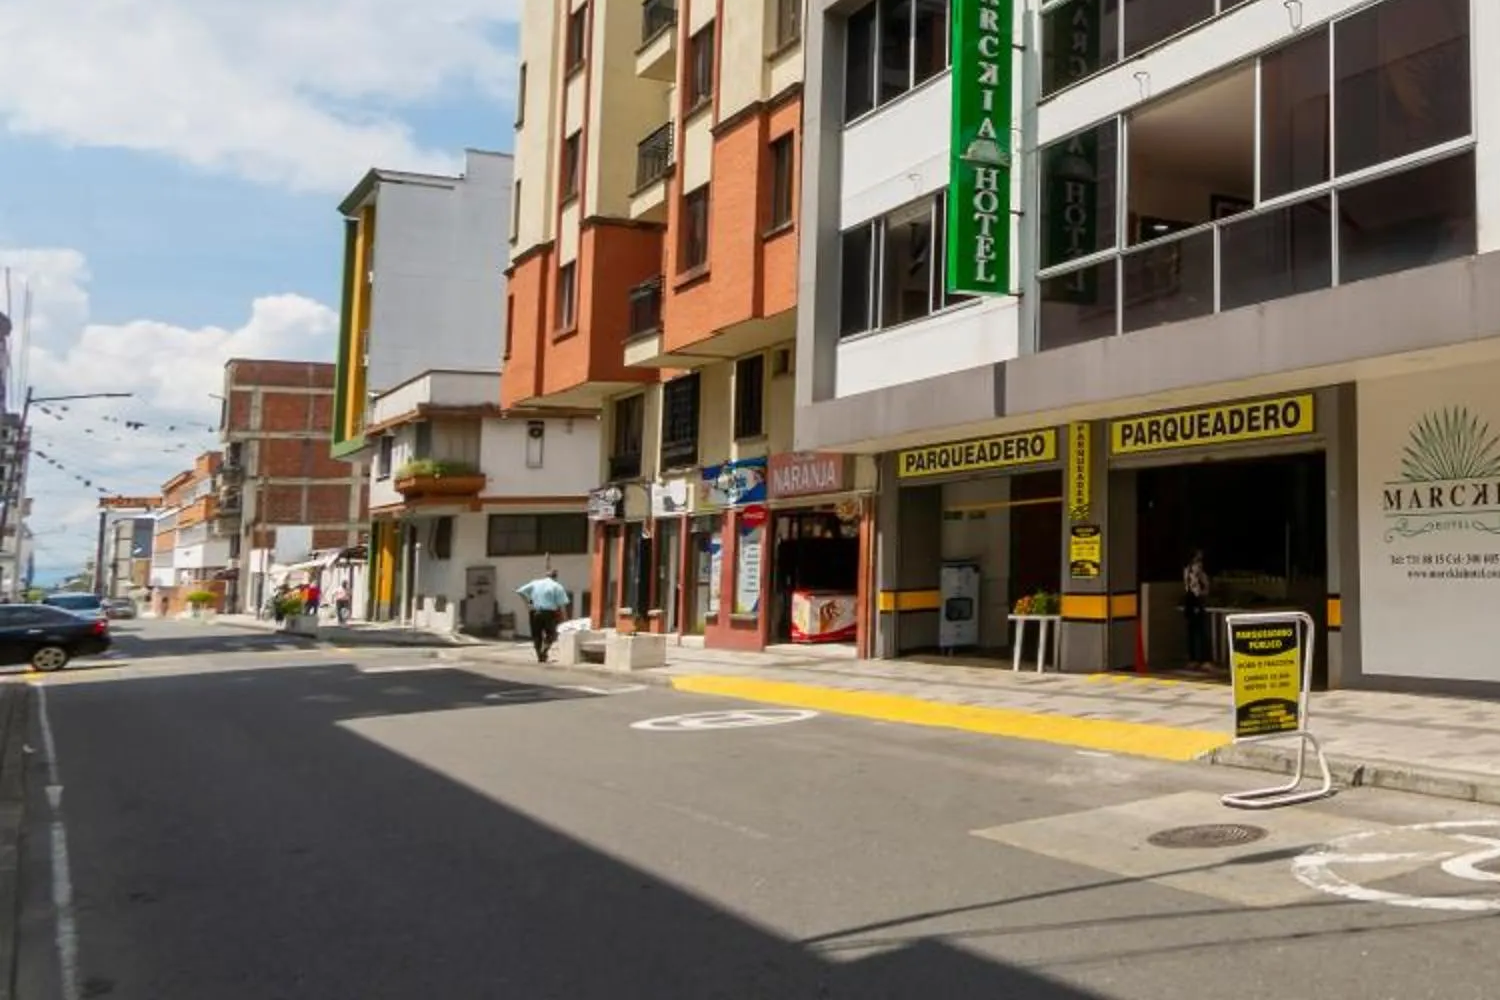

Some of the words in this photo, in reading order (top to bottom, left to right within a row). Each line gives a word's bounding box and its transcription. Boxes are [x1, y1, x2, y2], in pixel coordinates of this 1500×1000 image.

[972, 166, 1000, 283] HOTEL
[1120, 400, 1302, 447] PARQUEADERO
[905, 434, 1046, 472] PARQUEADERO
[773, 460, 836, 493] NARANJA
